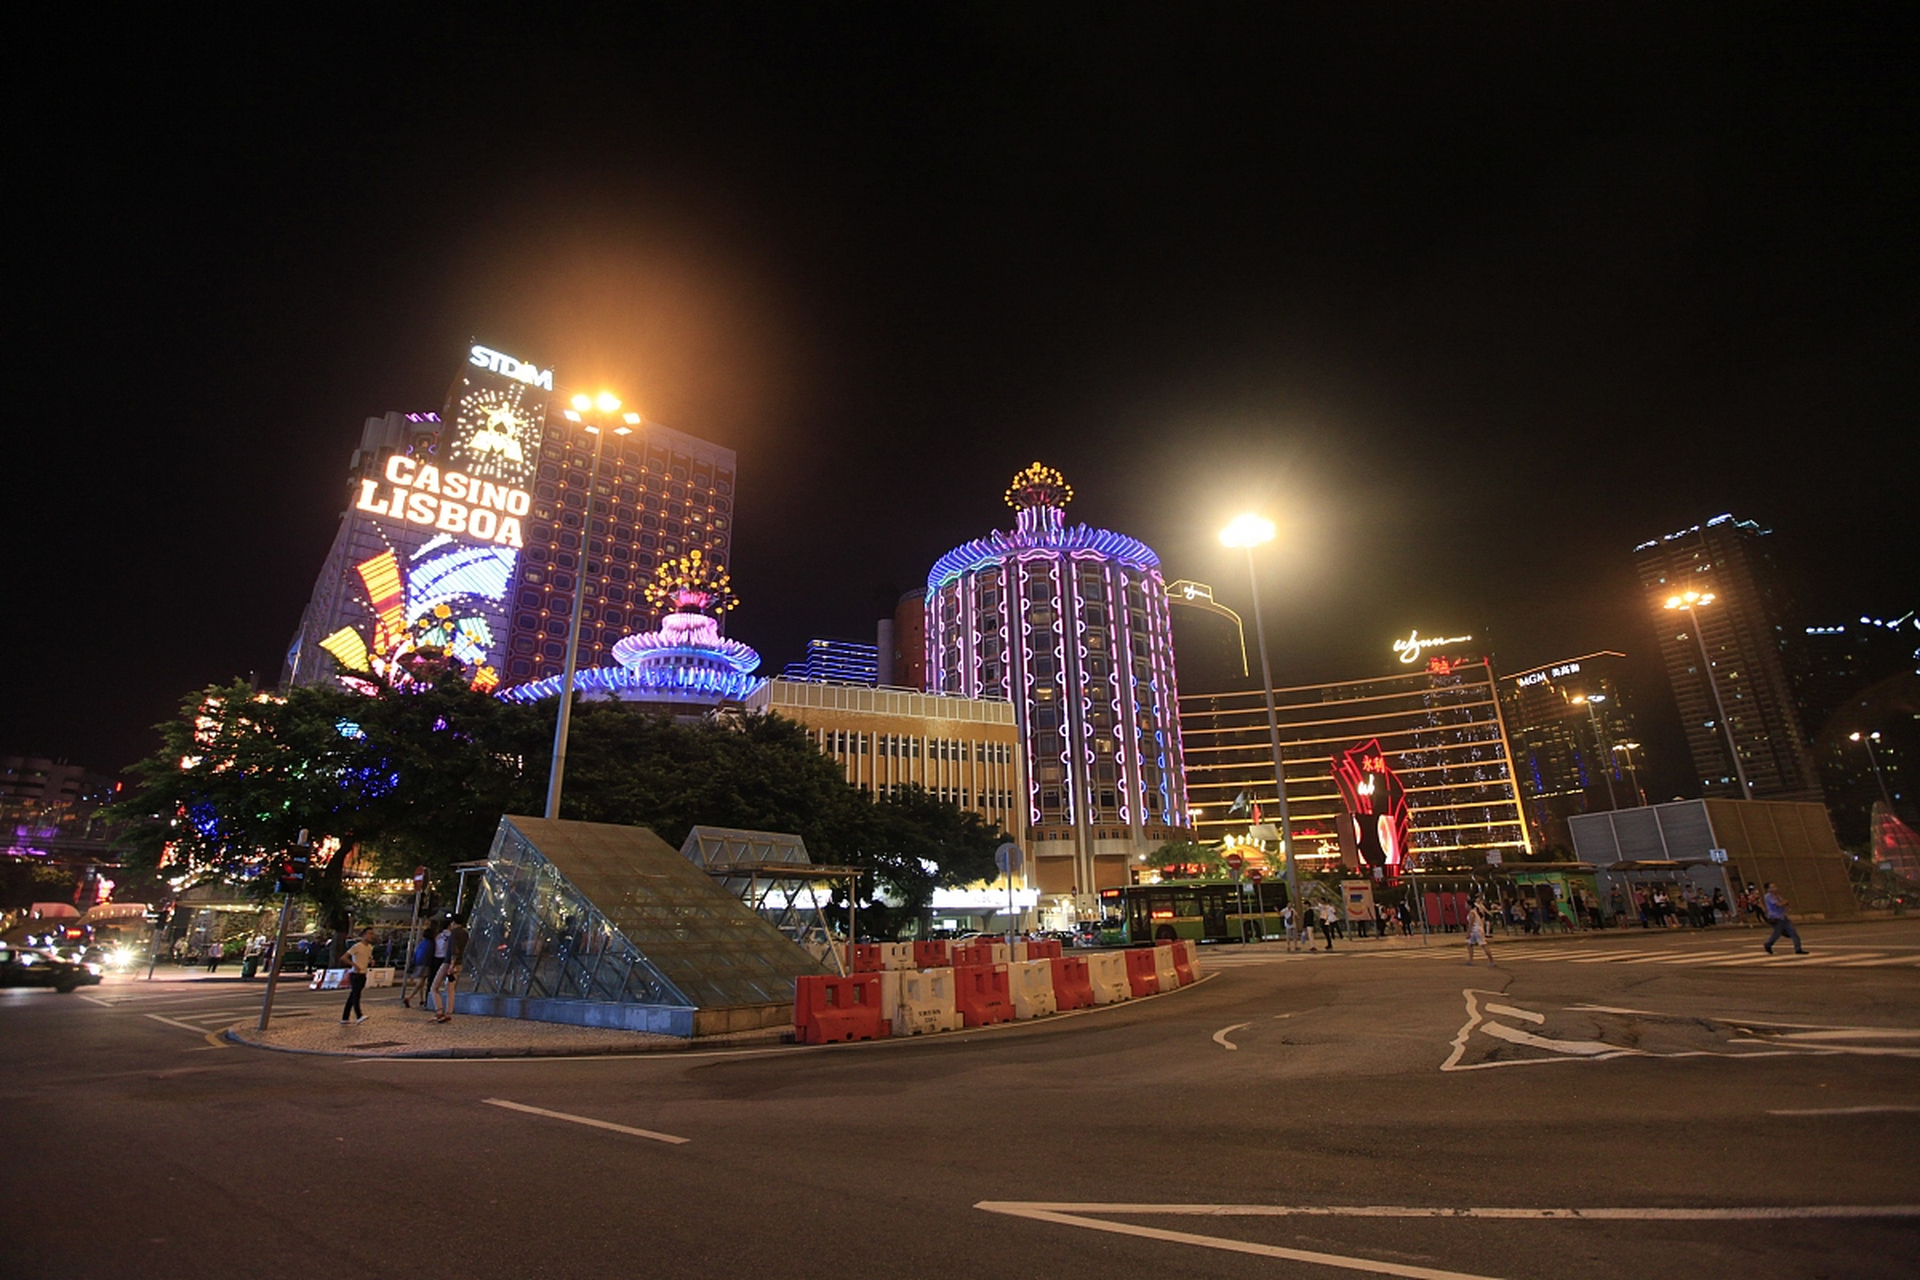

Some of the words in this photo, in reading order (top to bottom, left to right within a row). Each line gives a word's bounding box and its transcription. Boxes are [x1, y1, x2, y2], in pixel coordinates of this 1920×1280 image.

[469, 345, 553, 391] STDM
[385, 455, 531, 516] CASINO
[356, 478, 523, 548] LISBOA
[1519, 671, 1547, 688] MGM
